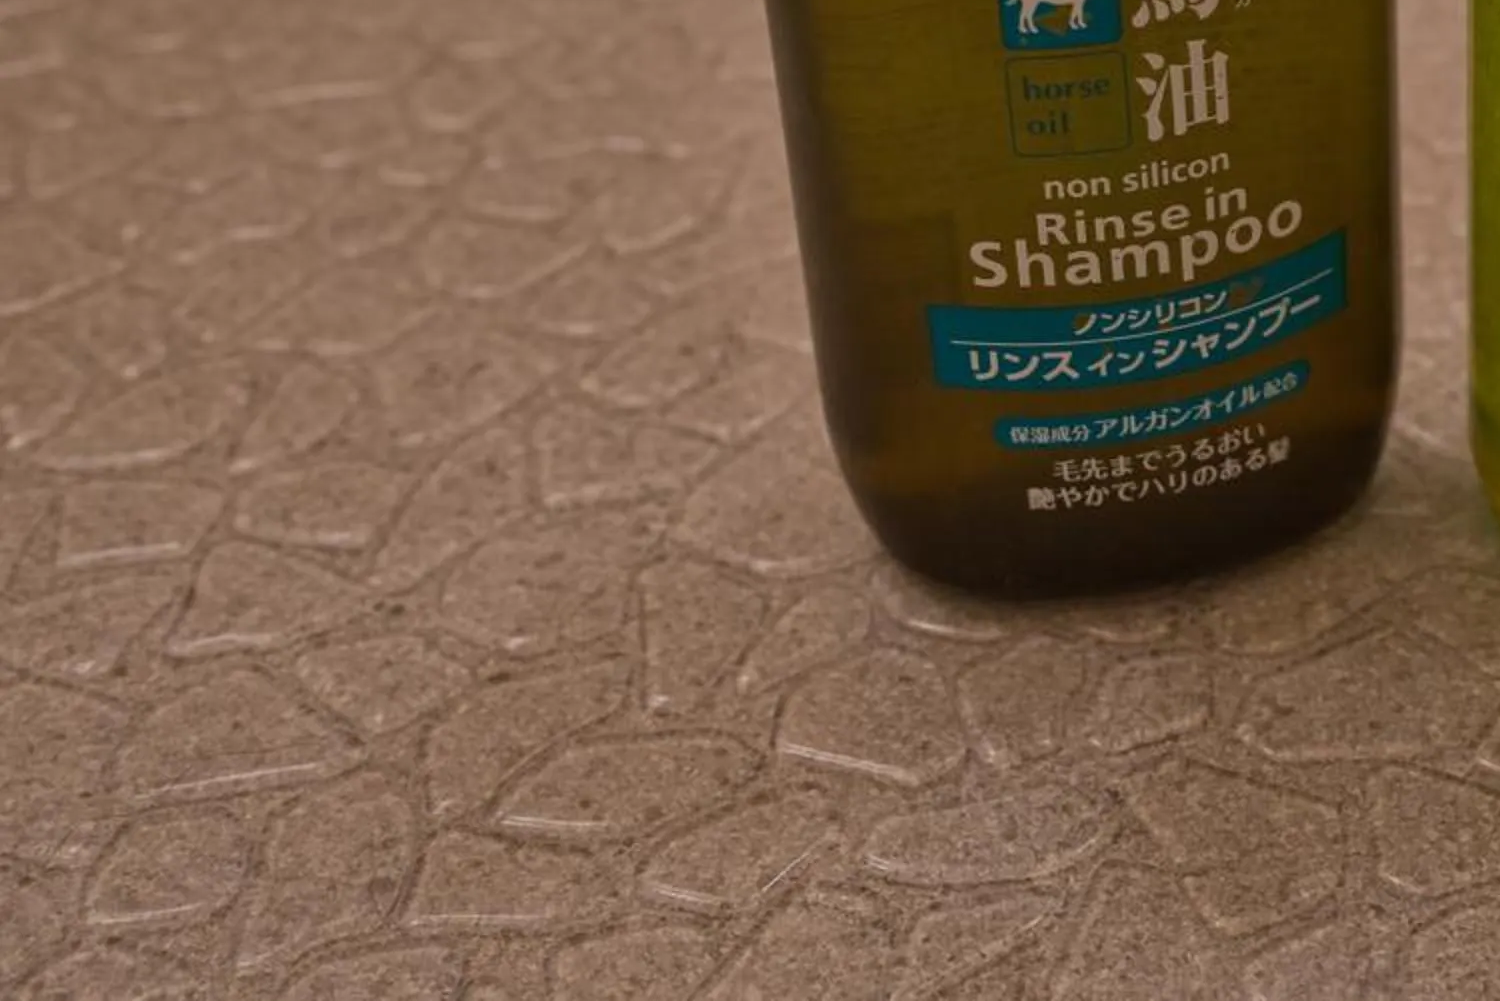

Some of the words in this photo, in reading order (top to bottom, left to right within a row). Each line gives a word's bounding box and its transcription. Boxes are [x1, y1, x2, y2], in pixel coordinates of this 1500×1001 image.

[1022, 75, 1111, 102] horse
[1026, 110, 1071, 136] oil
[1043, 173, 1111, 200] non
[1122, 151, 1230, 194] silicon
[1035, 202, 1191, 246] Rinse
[1205, 187, 1248, 222] in
[968, 200, 1302, 288] Shampoo
[1073, 290, 1228, 337] ノンシリコン
[1053, 423, 1266, 484] 毛先までうるおい
